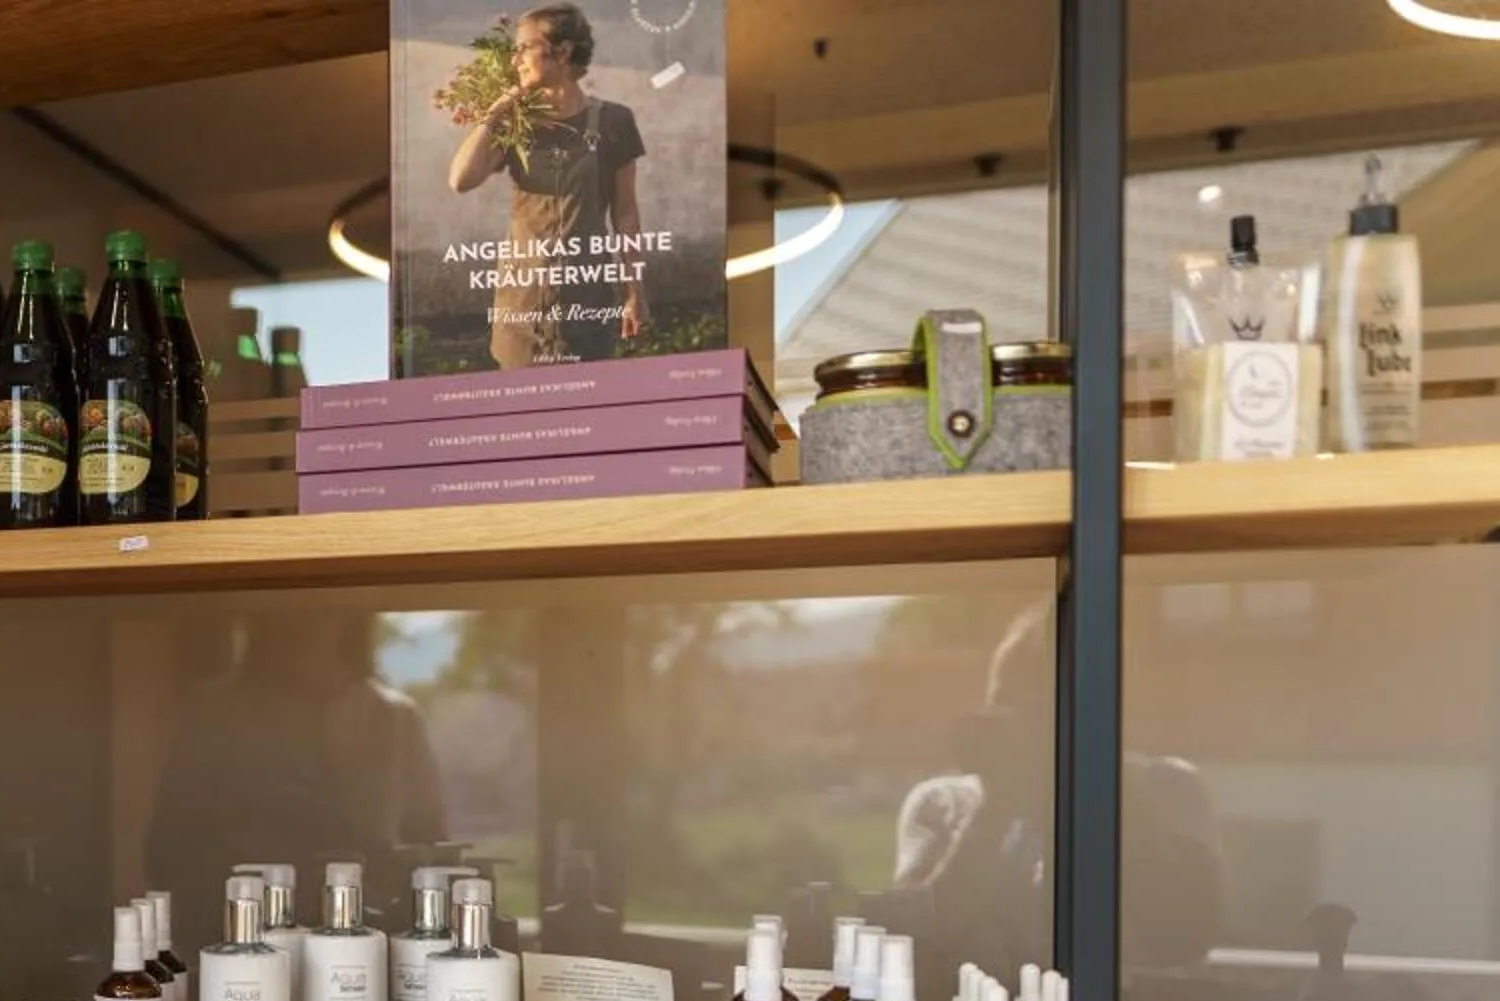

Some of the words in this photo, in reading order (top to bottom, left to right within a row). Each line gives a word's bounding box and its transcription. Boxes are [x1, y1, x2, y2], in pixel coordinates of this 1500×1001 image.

[443, 237, 582, 263] ANGELIKAS
[589, 231, 673, 255] BUNTE
[469, 262, 647, 290] KRÄUTERWELT
[487, 307, 542, 325] Wissen
[546, 304, 563, 322] &
[566, 302, 632, 325] Rezepte
